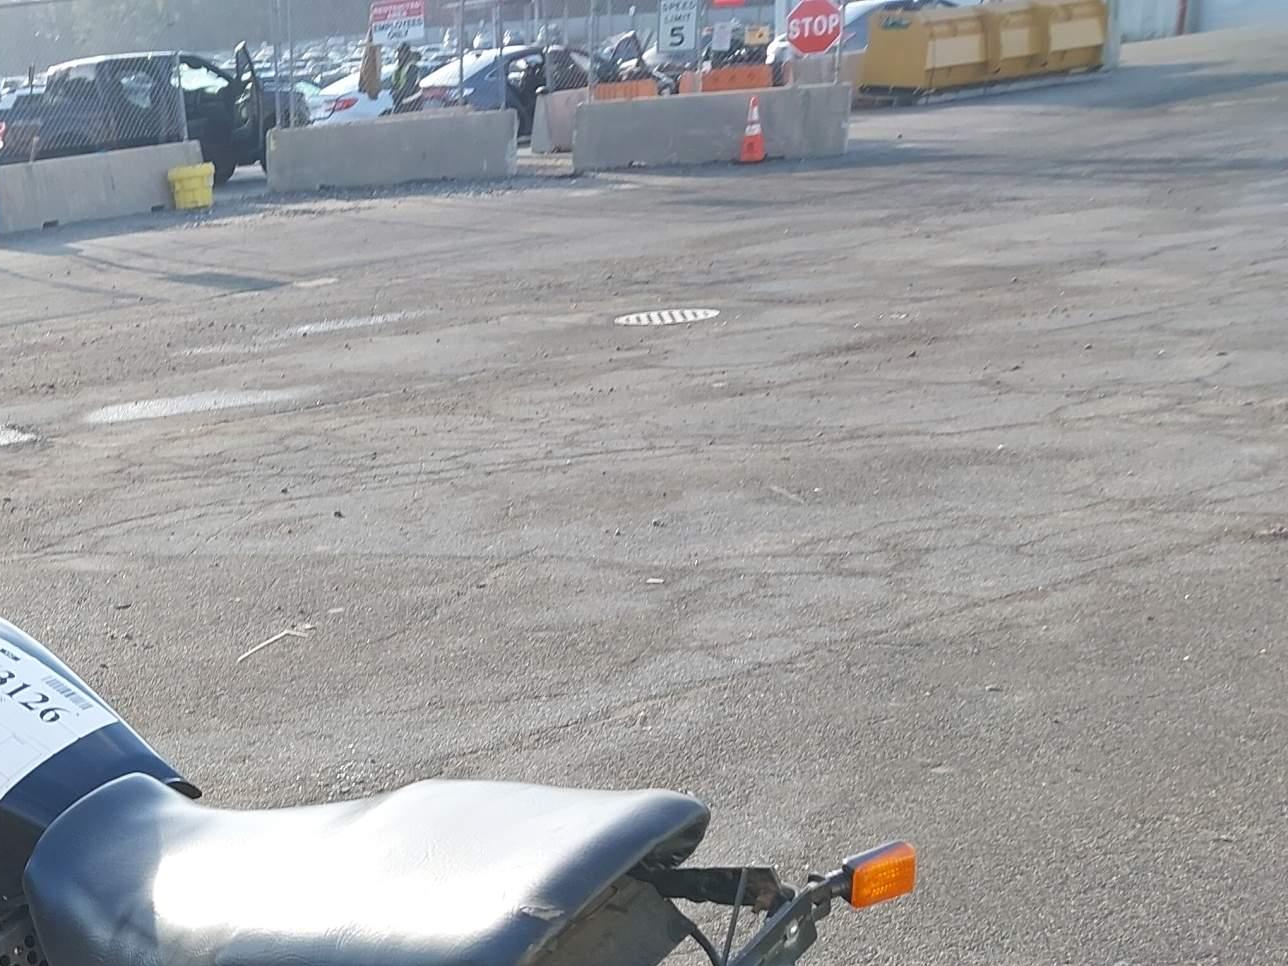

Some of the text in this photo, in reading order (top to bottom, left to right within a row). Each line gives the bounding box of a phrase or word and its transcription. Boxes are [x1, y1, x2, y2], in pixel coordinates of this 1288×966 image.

[662, 0, 696, 11] SPEED
[664, 13, 691, 23] LIMIT
[374, 18, 423, 31] EMPLOYEES
[789, 14, 840, 41] STOP
[387, 29, 409, 40] ONLY
[669, 26, 685, 47] 5
